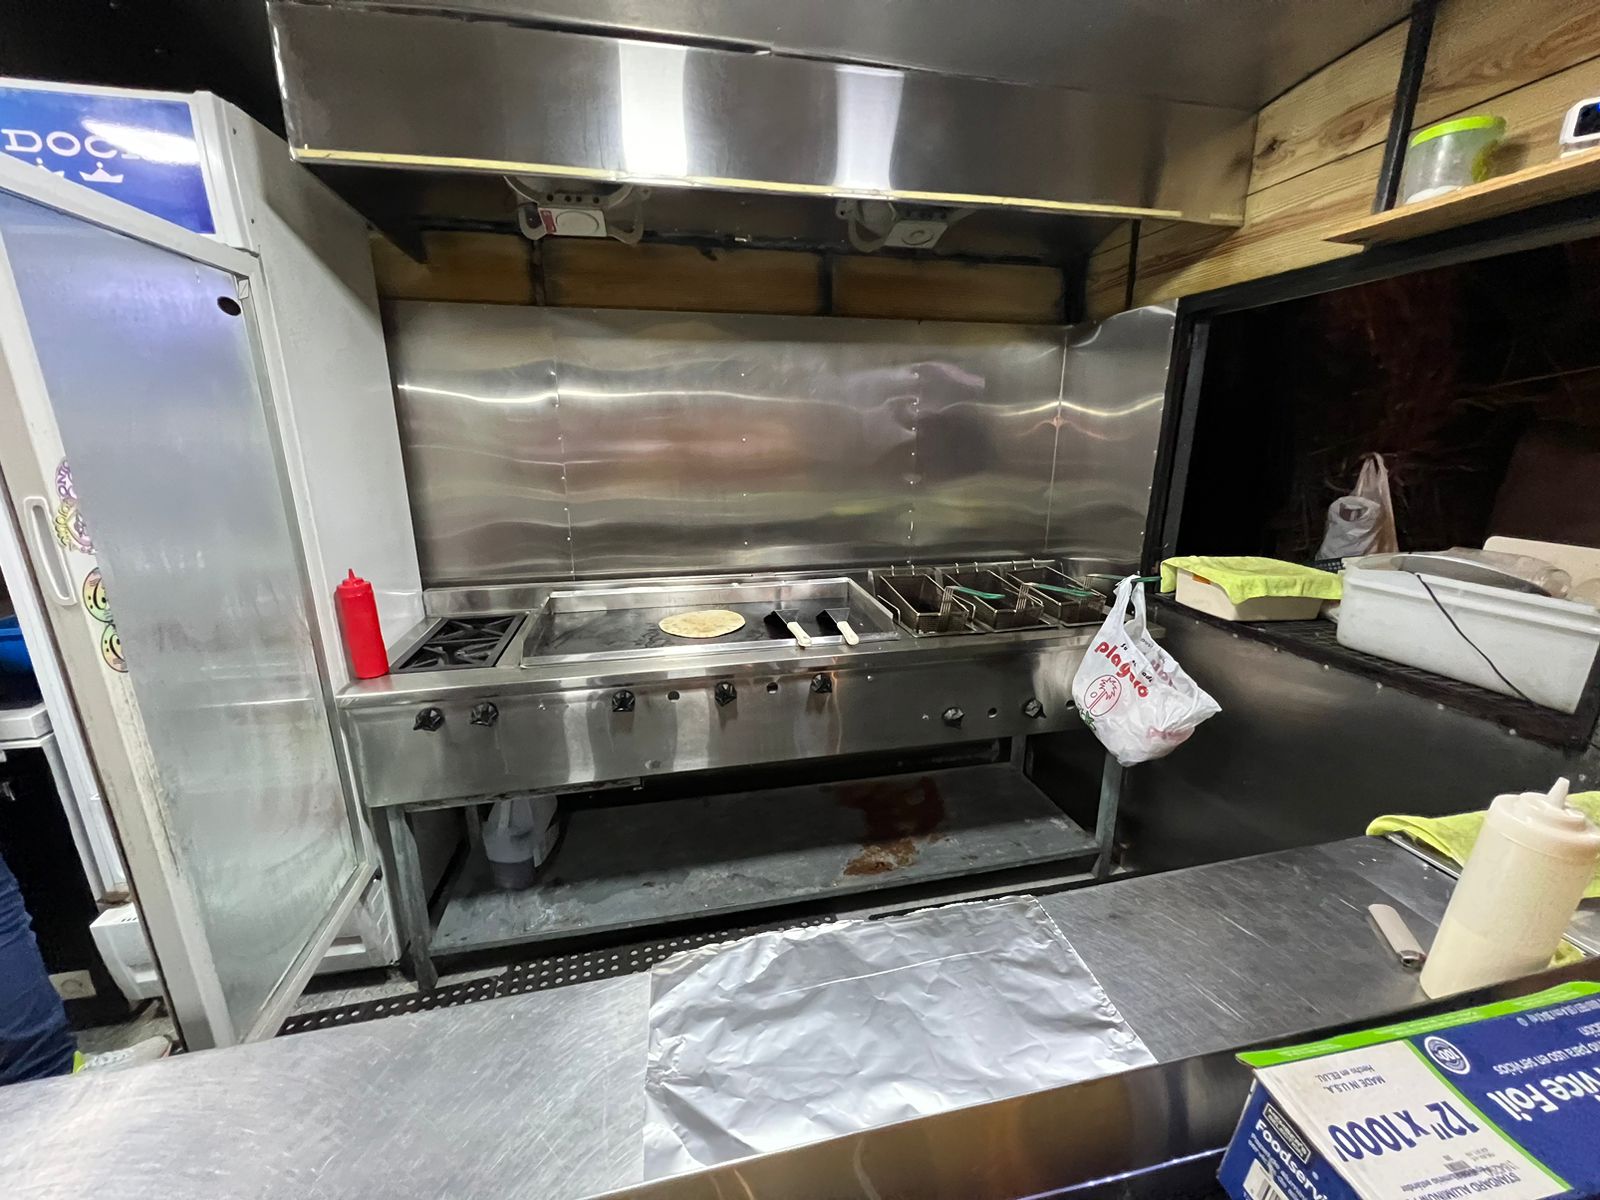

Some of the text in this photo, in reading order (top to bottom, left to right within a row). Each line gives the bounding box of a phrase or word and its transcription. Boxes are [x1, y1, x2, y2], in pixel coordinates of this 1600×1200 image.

[1, 129, 140, 160] DOC
[1534, 1055, 1551, 1065] en
[1547, 1050, 1570, 1062] uso
[1350, 1064, 1375, 1074] Hecho
[1492, 1057, 1537, 1075] servicios
[1323, 1075, 1386, 1094] MADE IN U.S.A.
[1486, 1067, 1600, 1121] vice Foil
[1469, 1172, 1521, 1192] STANDARD
